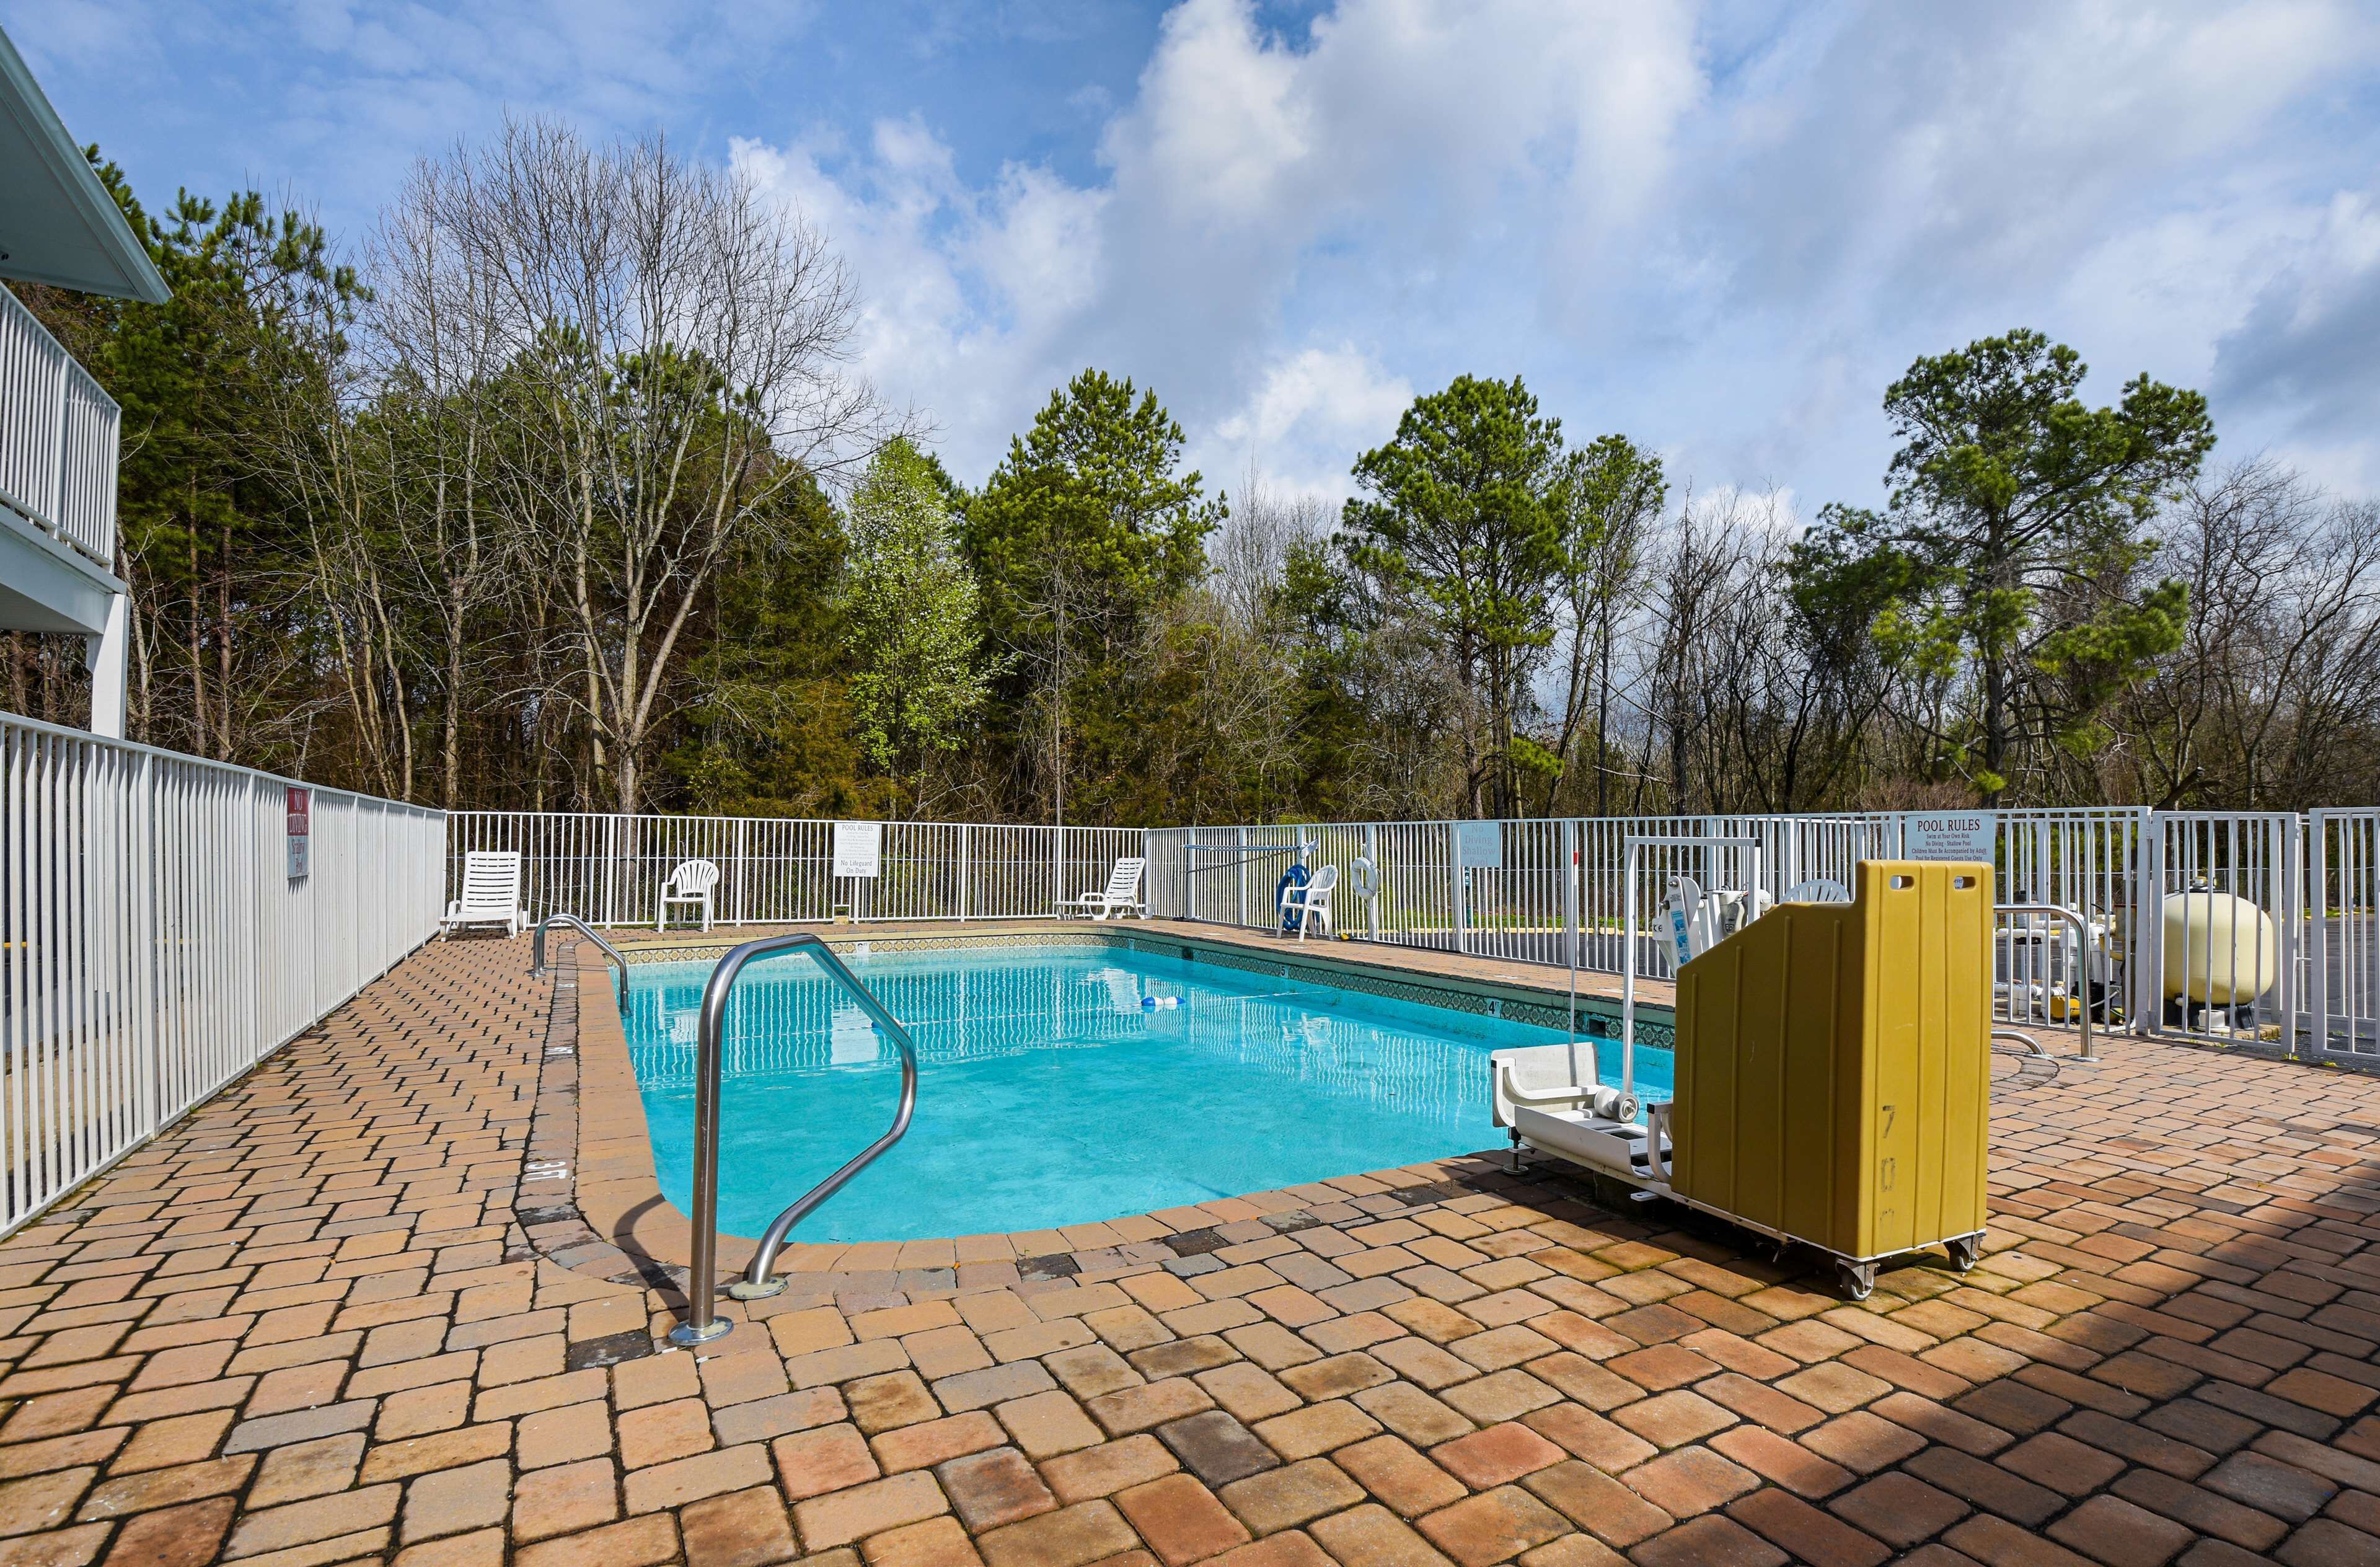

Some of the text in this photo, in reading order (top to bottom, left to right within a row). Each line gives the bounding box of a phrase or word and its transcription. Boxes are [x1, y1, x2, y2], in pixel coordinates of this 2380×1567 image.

[294, 790, 302, 811] NO
[289, 813, 307, 833] DIVING
[1472, 824, 1483, 833] No
[1918, 819, 1980, 831] POOL RULES
[1465, 835, 1492, 846] Diving
[1463, 847, 1496, 855] Shallow
[1470, 857, 1488, 866] Pool
